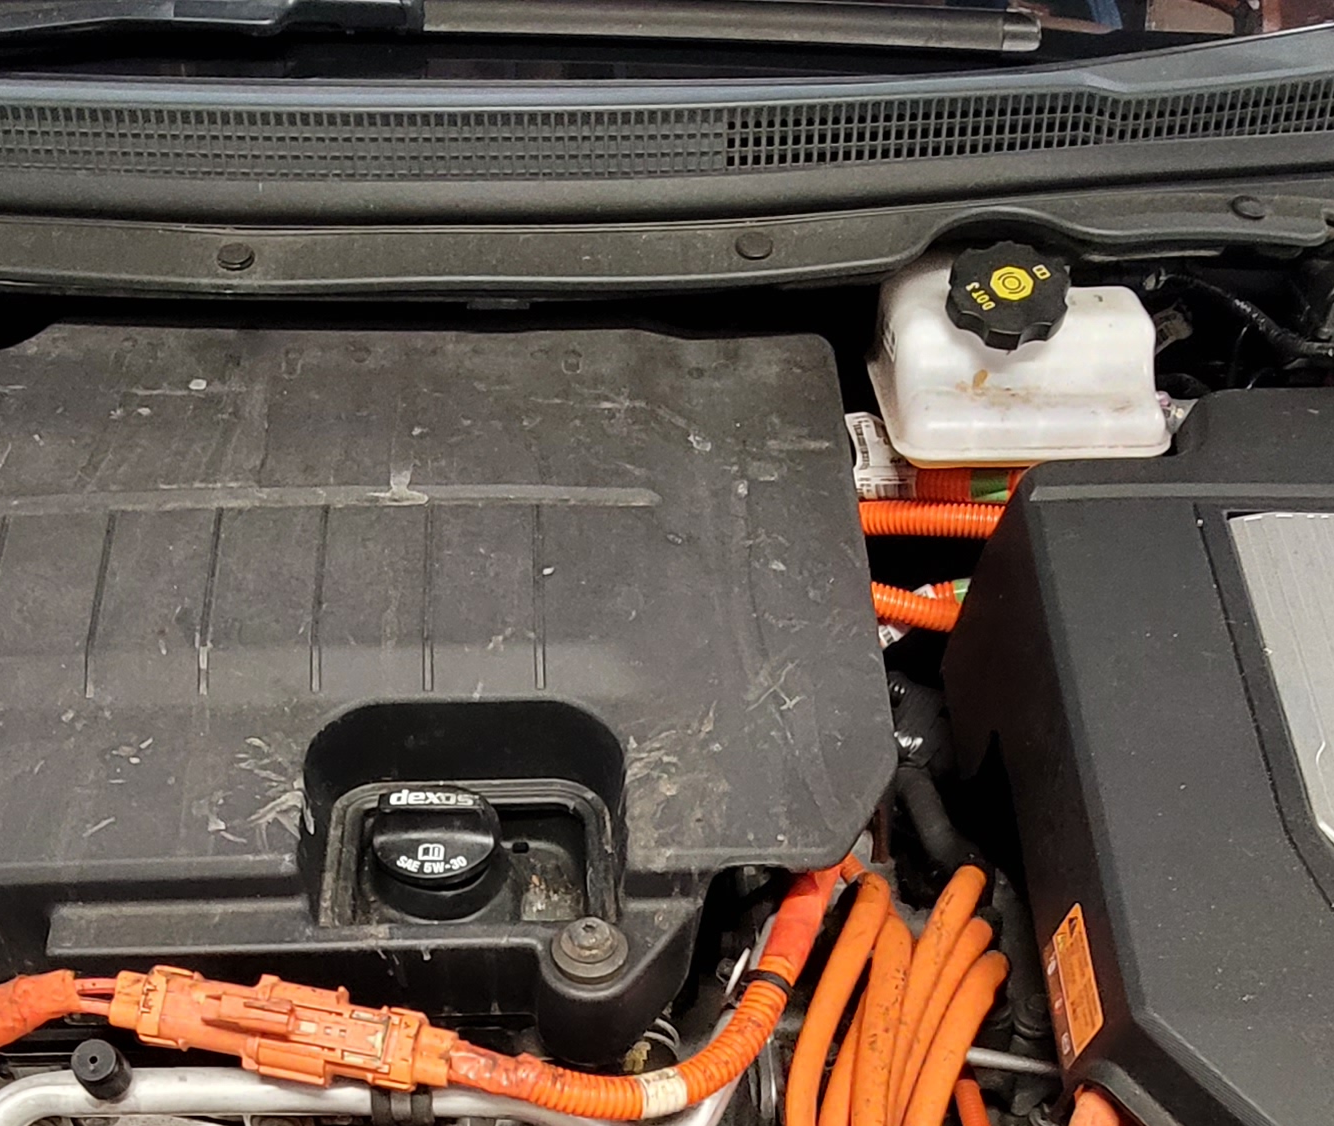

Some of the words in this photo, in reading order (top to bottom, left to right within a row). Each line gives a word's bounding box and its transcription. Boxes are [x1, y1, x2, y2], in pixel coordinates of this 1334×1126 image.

[971, 290, 996, 311] DOT
[389, 789, 474, 806] dexos
[395, 855, 421, 873] SAE
[423, 855, 467, 875] 5W-30
